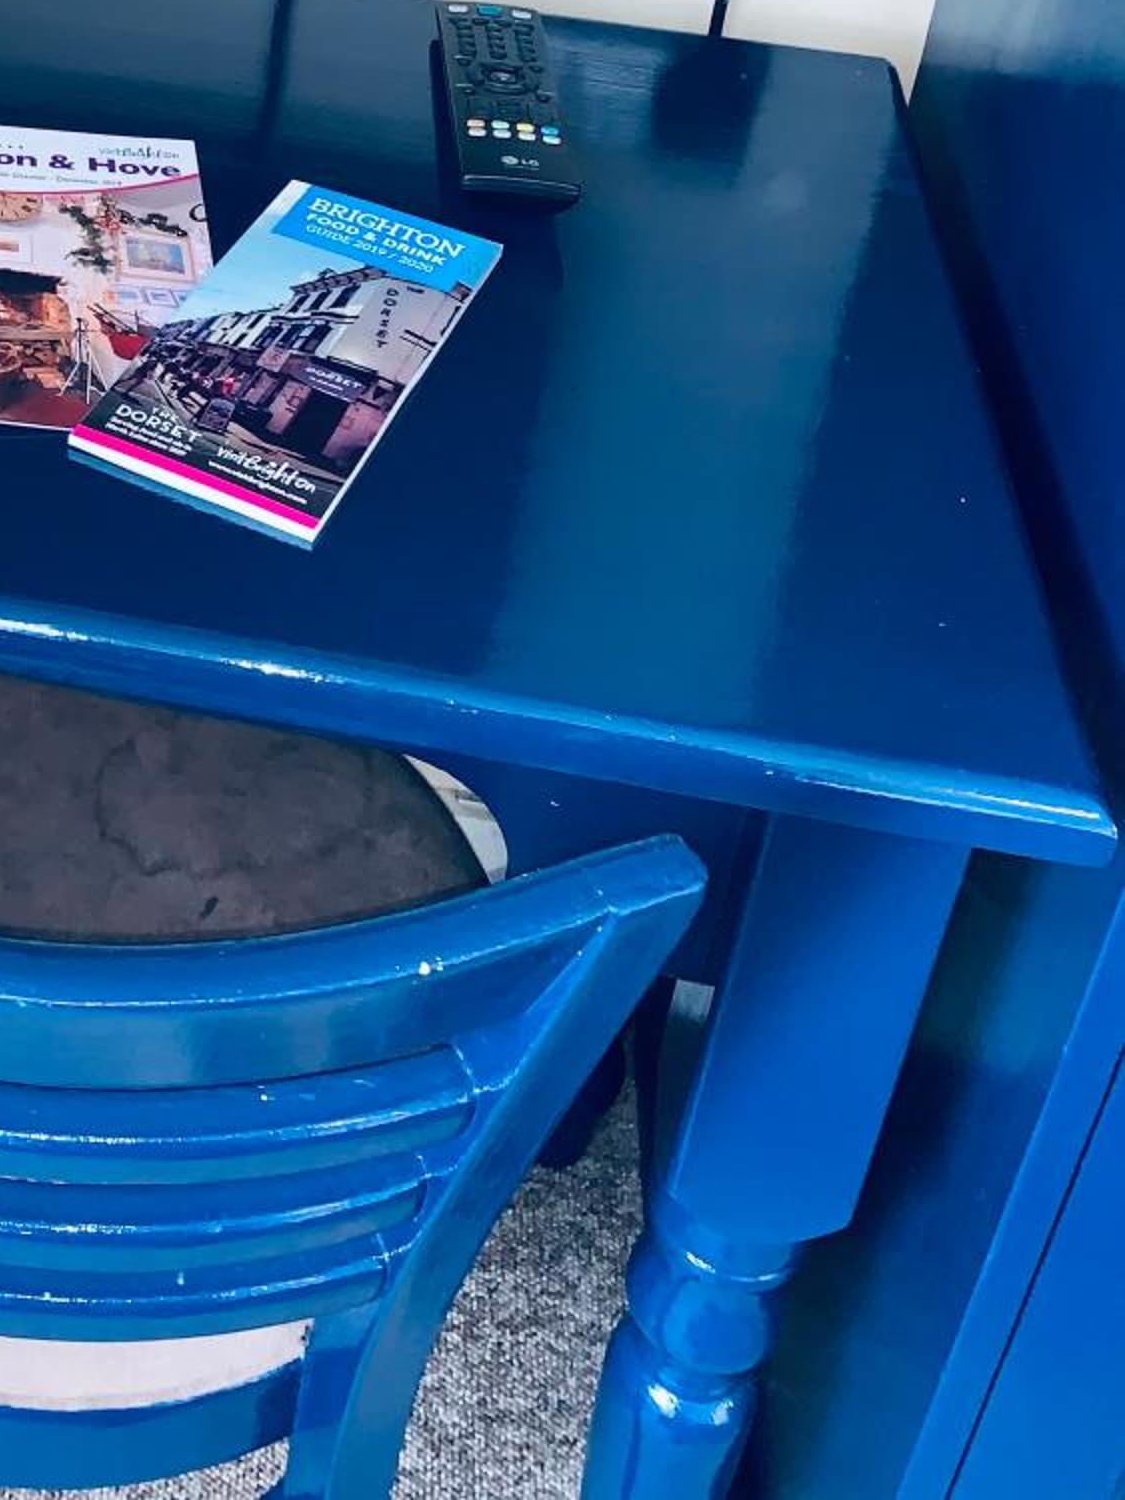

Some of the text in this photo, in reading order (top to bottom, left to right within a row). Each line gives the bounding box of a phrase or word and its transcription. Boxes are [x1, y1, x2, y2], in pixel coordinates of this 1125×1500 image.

[48, 153, 76, 171] &
[88, 157, 181, 177] Hove
[306, 213, 447, 266] FOOD & DRINK
[306, 224, 351, 246] GUIDE
[398, 256, 435, 273] 2020
[309, 197, 466, 258] BRIGHTON
[116, 404, 202, 442] DORSET
